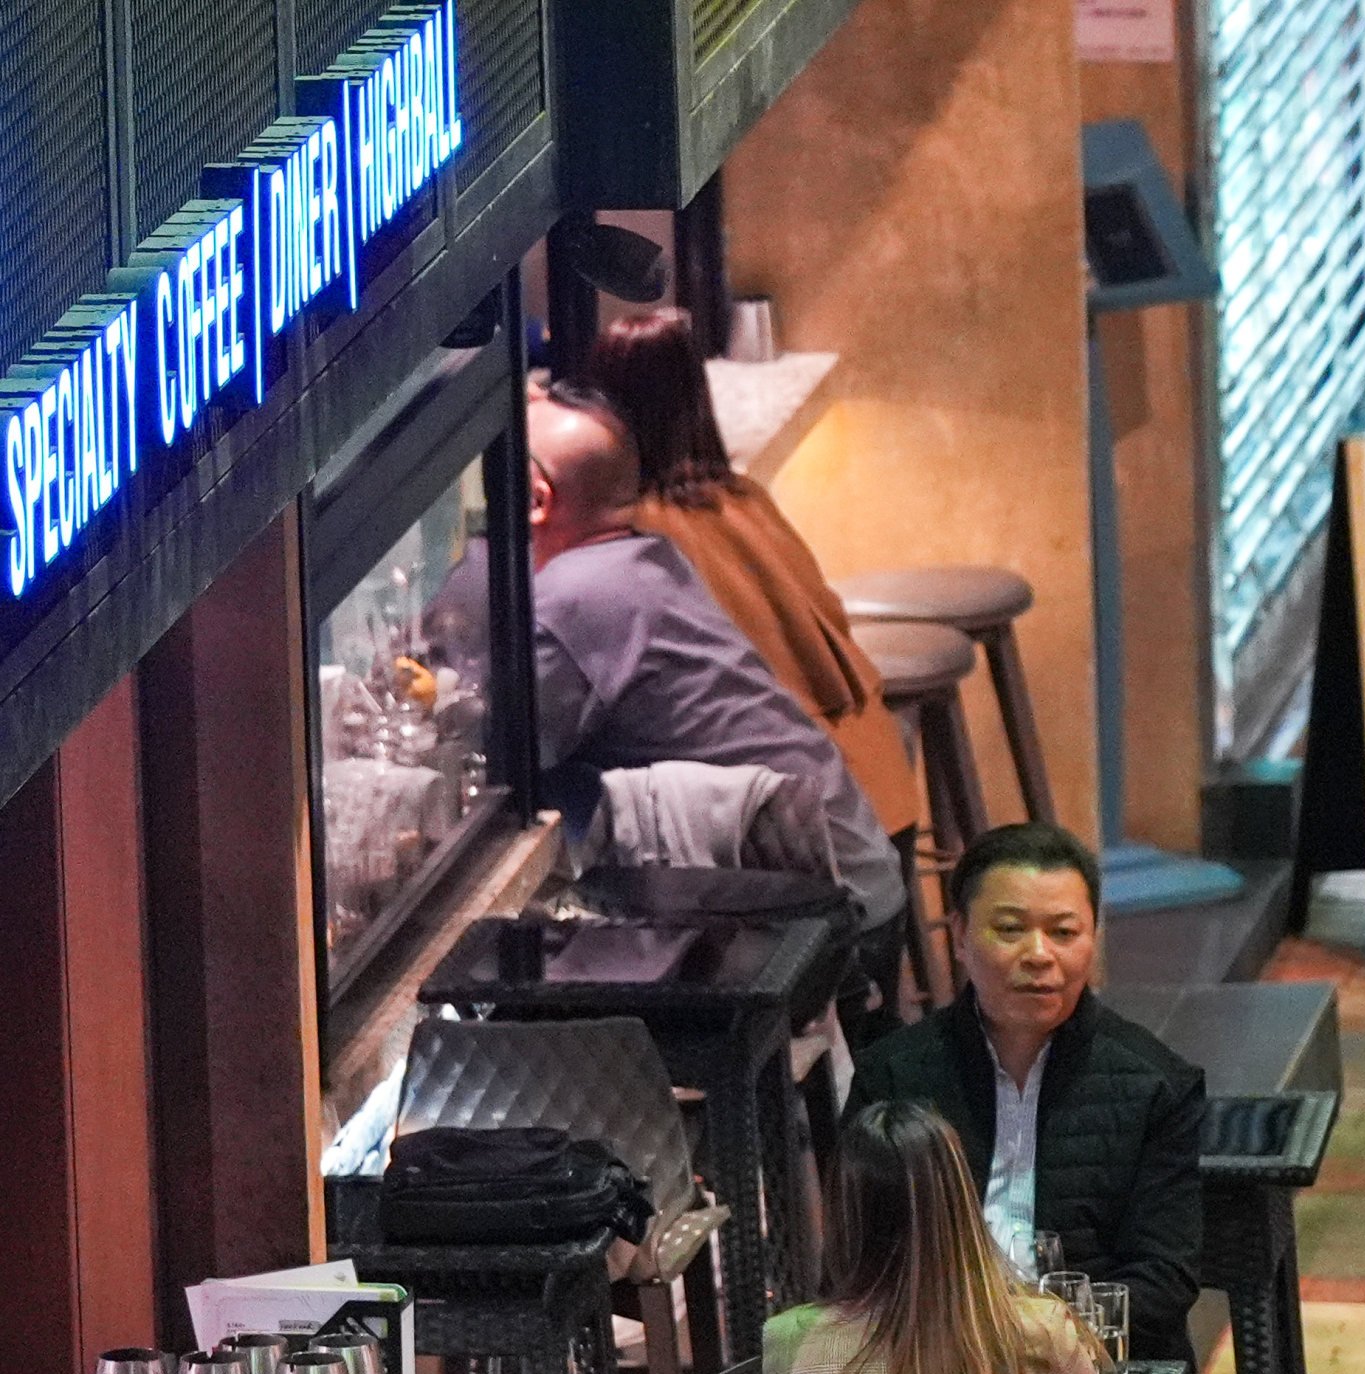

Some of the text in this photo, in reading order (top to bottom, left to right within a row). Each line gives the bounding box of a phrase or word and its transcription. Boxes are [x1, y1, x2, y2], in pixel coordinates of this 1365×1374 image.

[7, 0, 462, 597] SPECIALTY COFFEE DINER HIGHBALL
